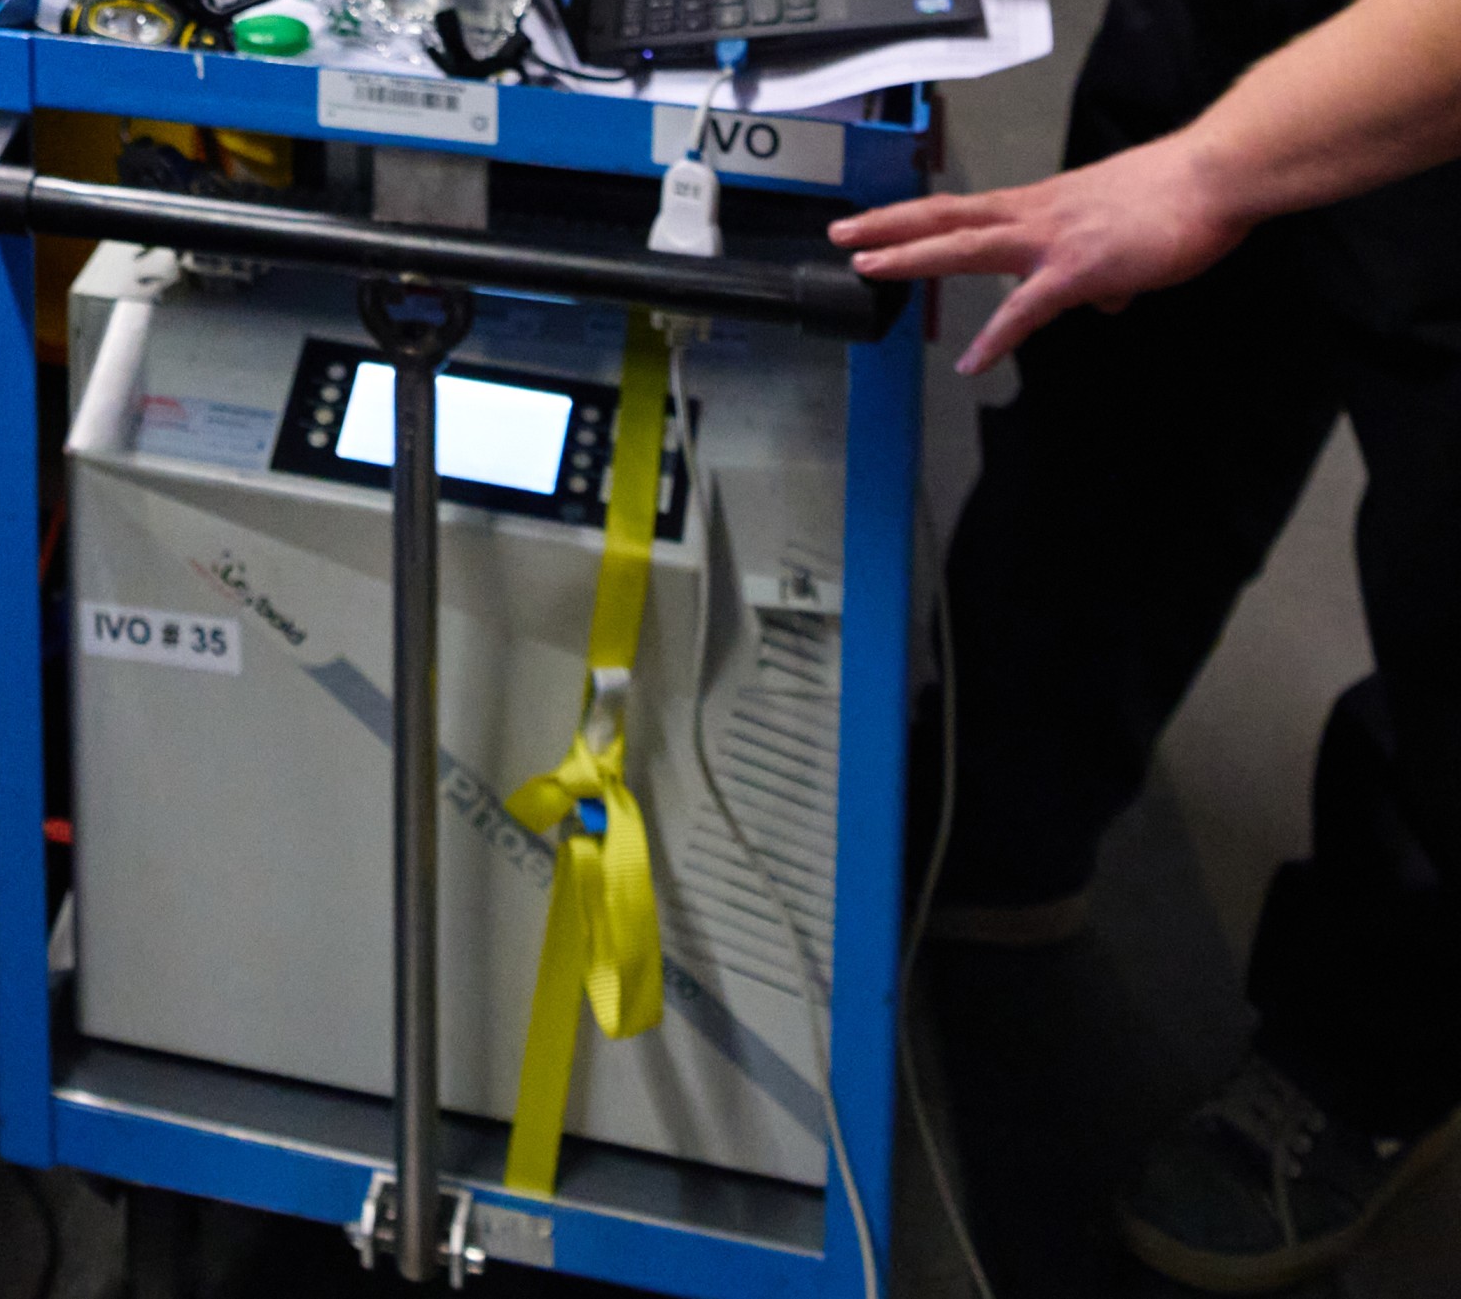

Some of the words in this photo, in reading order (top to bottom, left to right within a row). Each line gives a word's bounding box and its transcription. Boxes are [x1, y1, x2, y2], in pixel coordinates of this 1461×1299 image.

[702, 116, 780, 159] VO
[94, 611, 152, 645] IVO
[190, 624, 228, 658] 35
